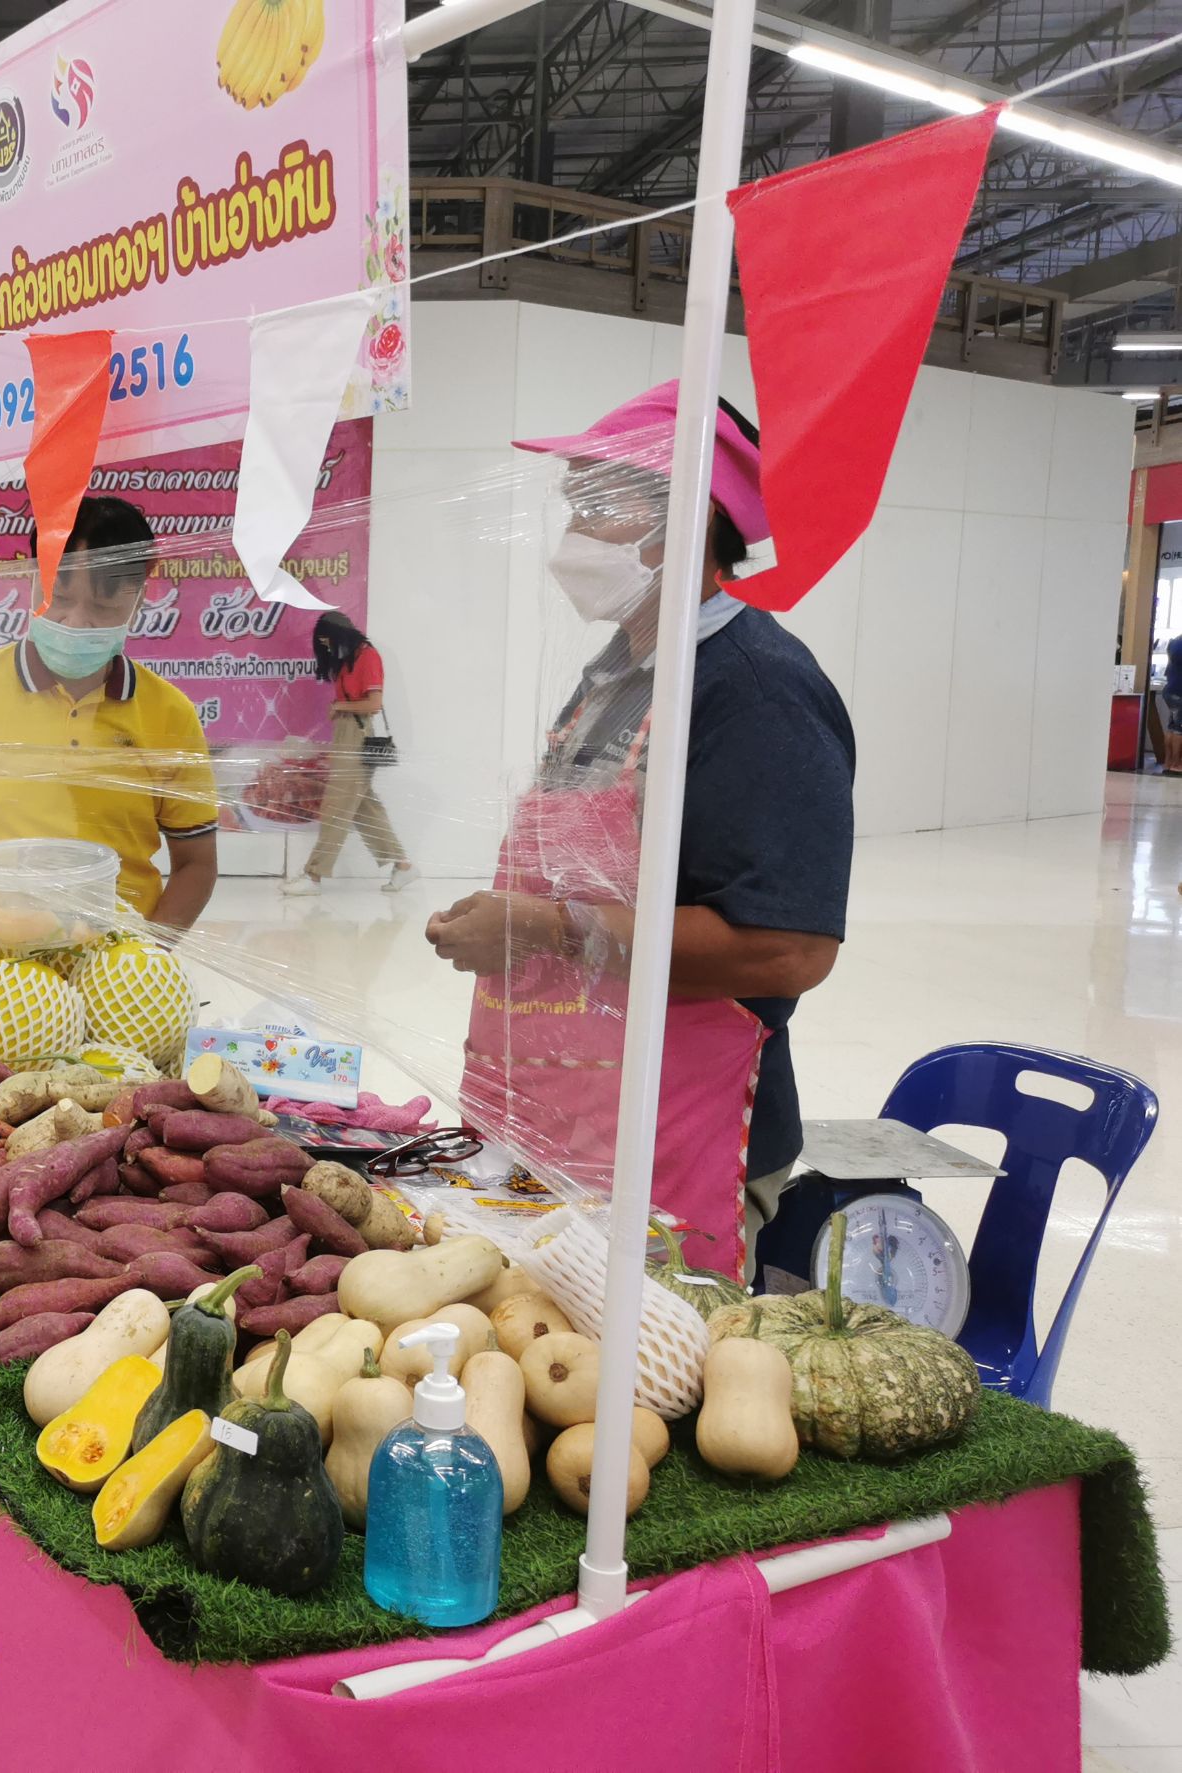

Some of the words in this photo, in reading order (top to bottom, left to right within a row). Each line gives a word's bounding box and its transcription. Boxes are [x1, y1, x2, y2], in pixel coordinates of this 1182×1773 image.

[51, 136, 105, 175] บทบาทสตรี
[173, 141, 335, 275] บ้านอ่างหิน
